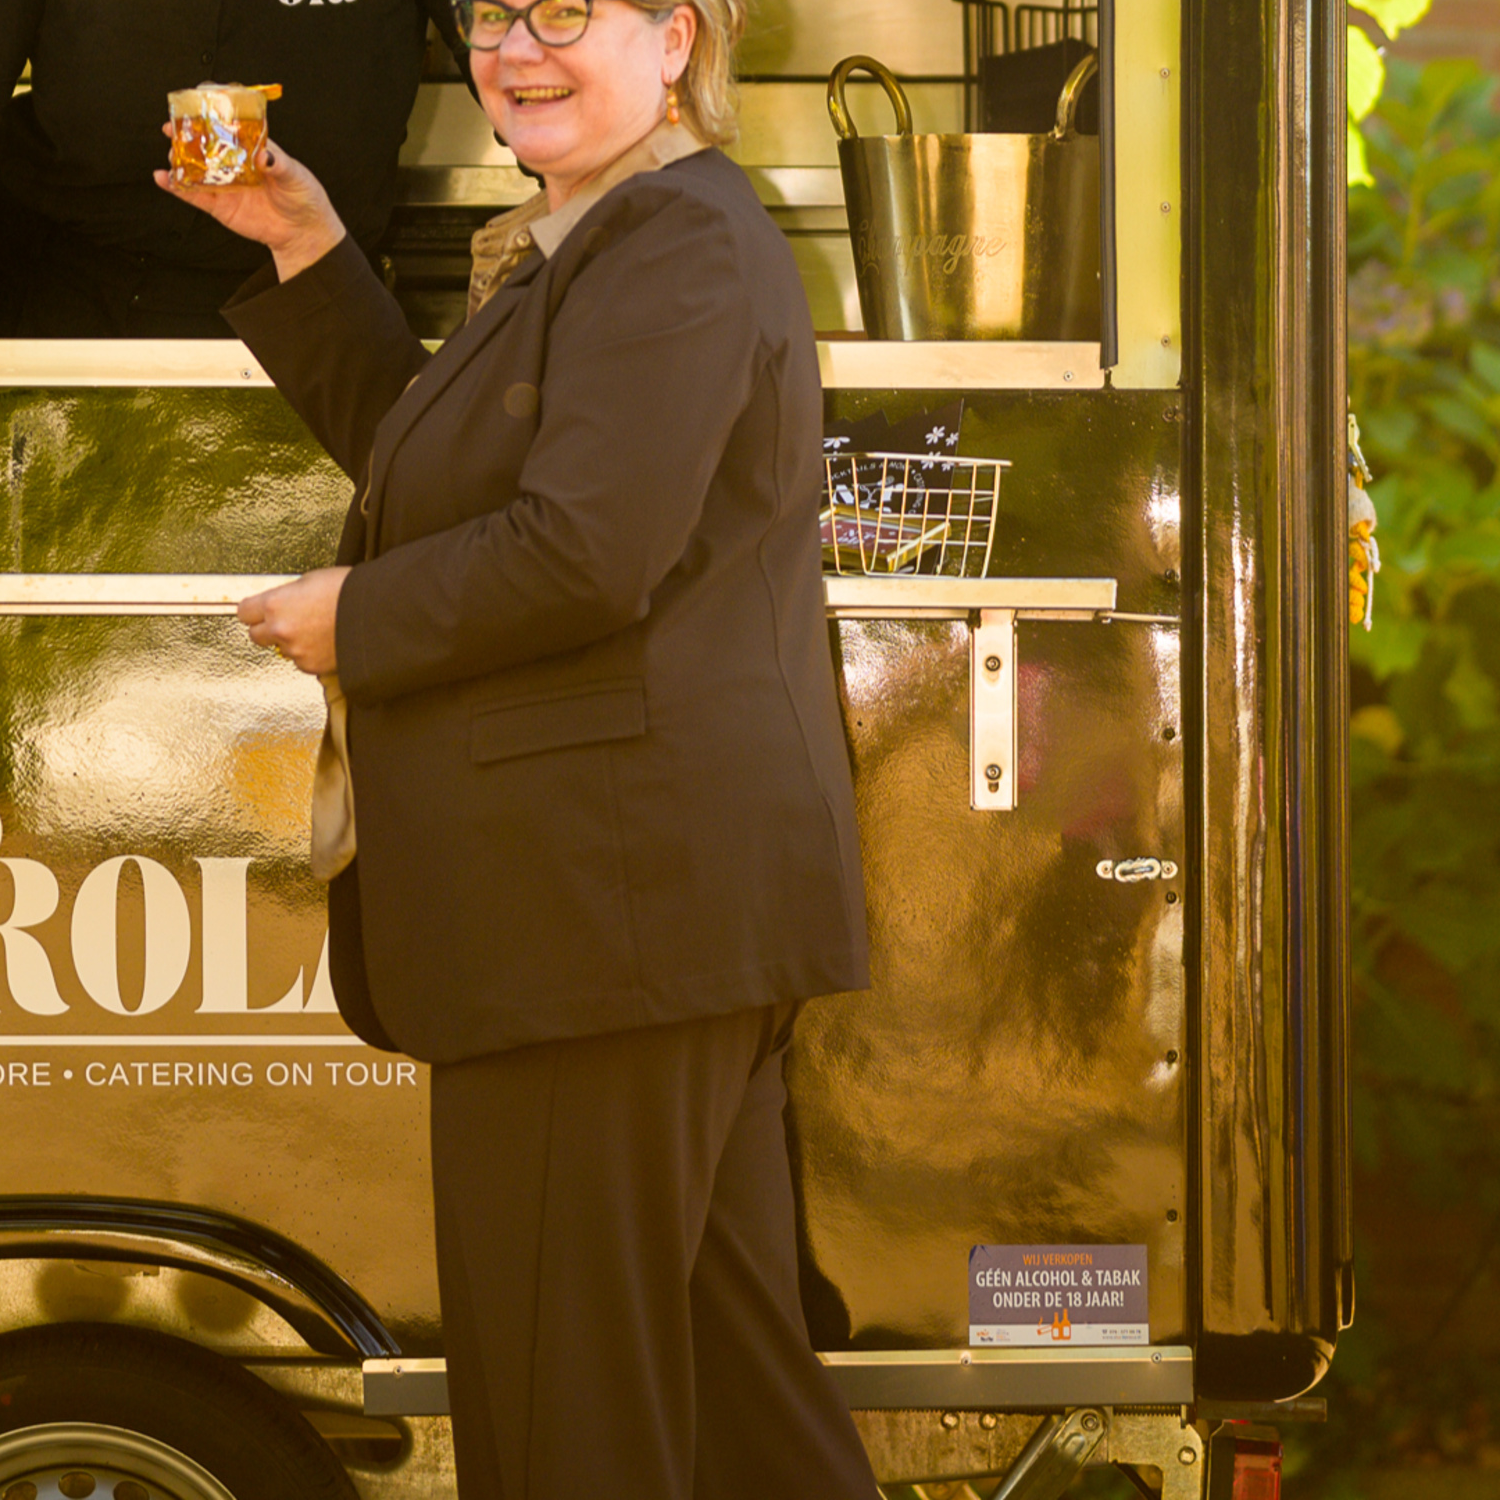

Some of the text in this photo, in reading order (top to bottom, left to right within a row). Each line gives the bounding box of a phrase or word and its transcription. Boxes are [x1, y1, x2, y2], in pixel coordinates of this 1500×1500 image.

[85, 1061, 254, 1087] CATERING
[265, 1061, 313, 1087] ON
[324, 1061, 417, 1087] TOUR
[1022, 1253, 1093, 1267] WIJ VERKOPEN
[975, 1268, 1141, 1288] GÉÉN ALCOHOL & TABAK
[992, 1290, 1124, 1308] ONDER DE 18 JAAR!
